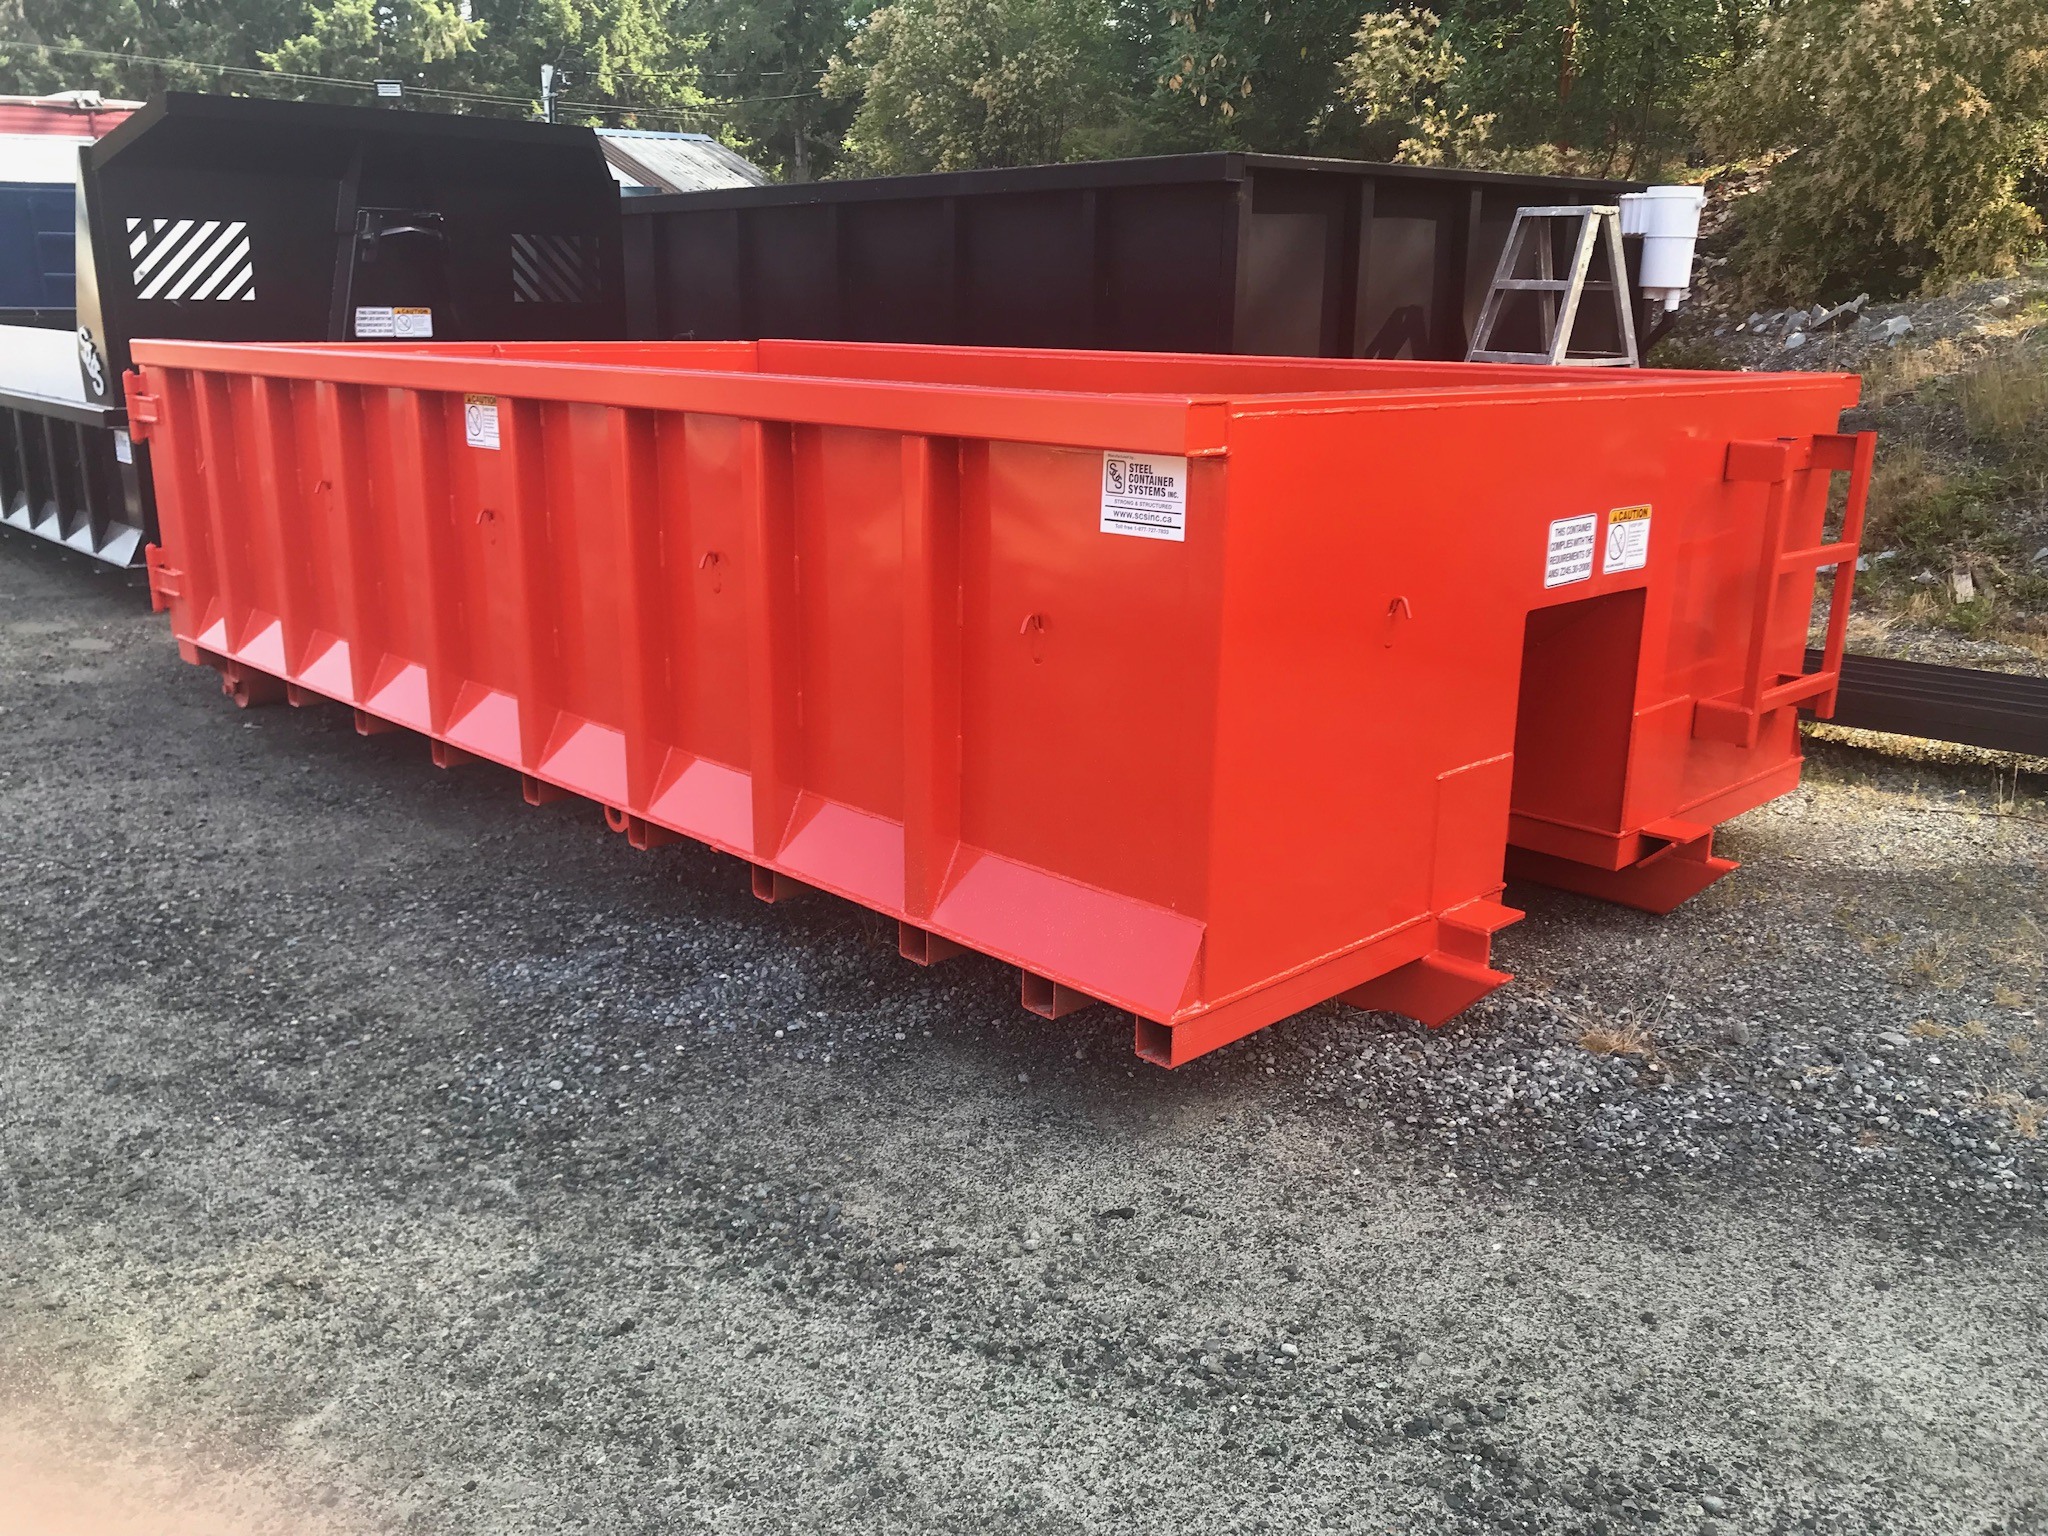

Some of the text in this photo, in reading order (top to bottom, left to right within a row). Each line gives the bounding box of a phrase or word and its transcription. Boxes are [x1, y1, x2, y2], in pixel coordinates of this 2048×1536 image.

[1129, 463, 1153, 474] STEEL
[1128, 474, 1174, 488] CONTAINER
[1128, 484, 1166, 497] SYSTEMS
[1140, 501, 1172, 510] STRUCTURED
[1113, 510, 1172, 523] www.scsinc.ca
[1619, 508, 1648, 520] CAUTION
[1555, 523, 1591, 537] THIS CONTAINER
[1550, 535, 1594, 552] COMPLIES WITH THE
[1549, 548, 1593, 565] REQUIREMENTS OF
[1548, 568, 1559, 578] ANSI
